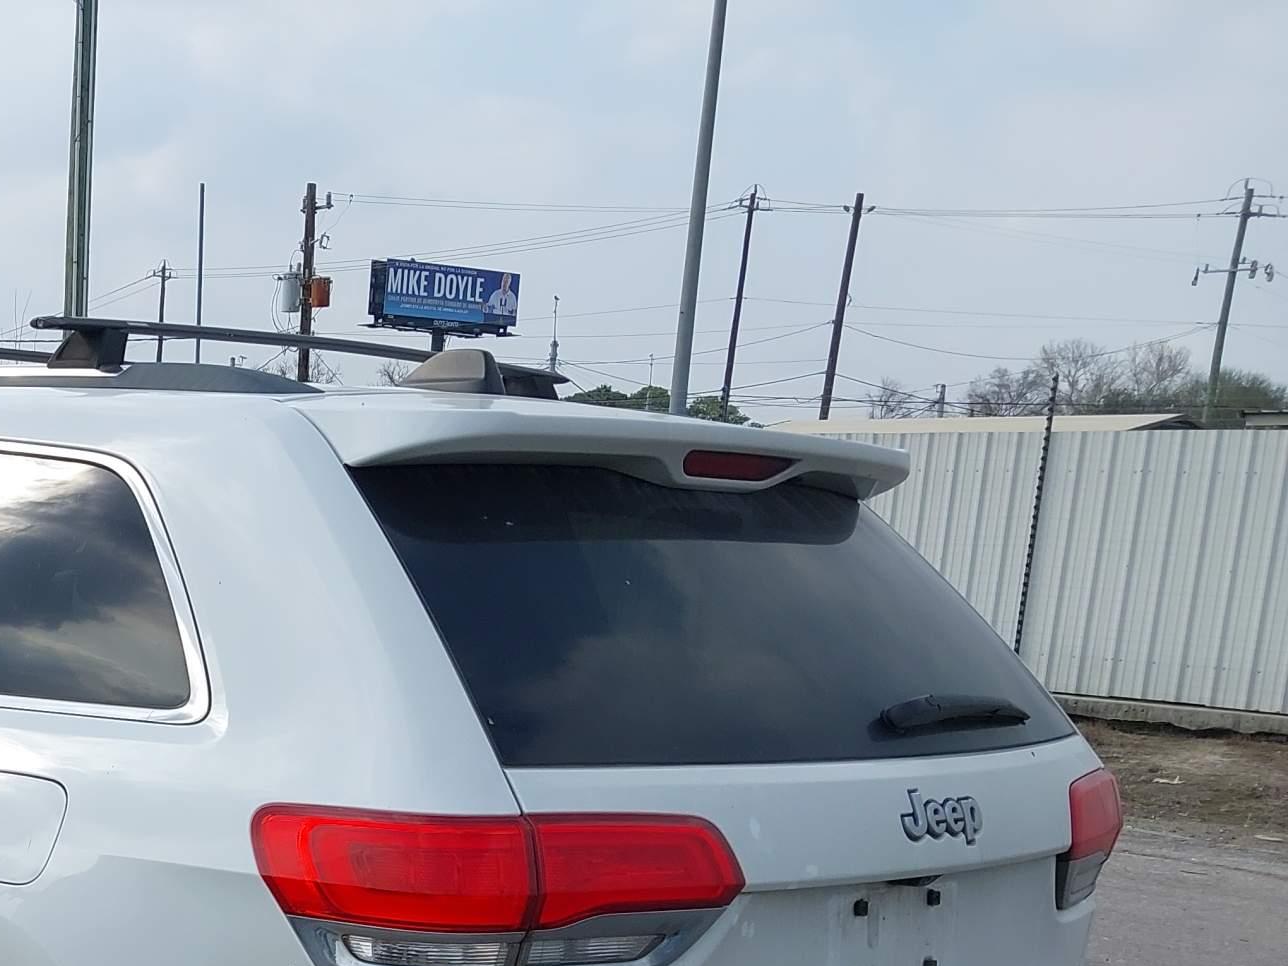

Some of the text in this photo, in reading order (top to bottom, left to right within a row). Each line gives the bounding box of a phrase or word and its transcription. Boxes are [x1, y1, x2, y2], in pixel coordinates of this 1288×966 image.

[387, 267, 430, 297] MIKE
[433, 272, 485, 303] DOYLE
[900, 788, 983, 846] Jeep
